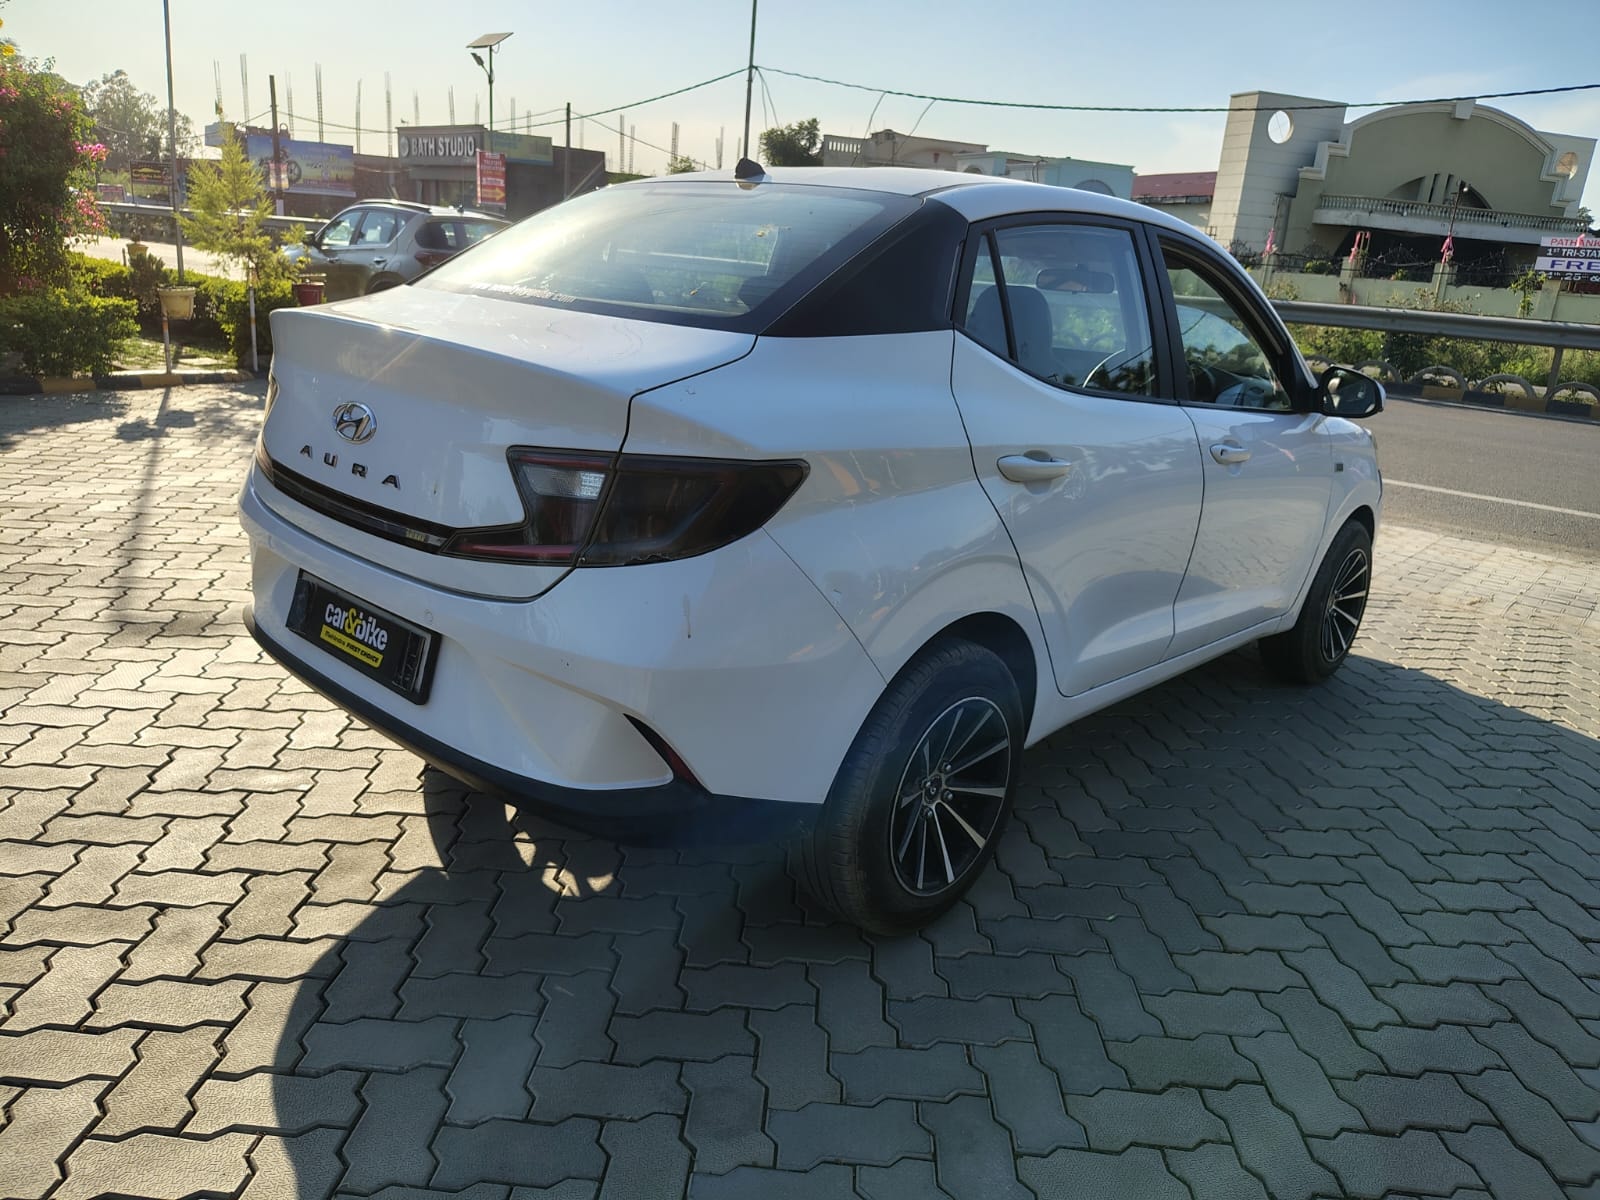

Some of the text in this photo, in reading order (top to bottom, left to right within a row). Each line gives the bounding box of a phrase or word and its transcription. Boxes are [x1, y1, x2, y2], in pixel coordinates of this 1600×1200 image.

[411, 136, 435, 157] BATH
[438, 135, 475, 157] STUDIO
[299, 444, 401, 491] AURA
[325, 603, 388, 651] car&bike
